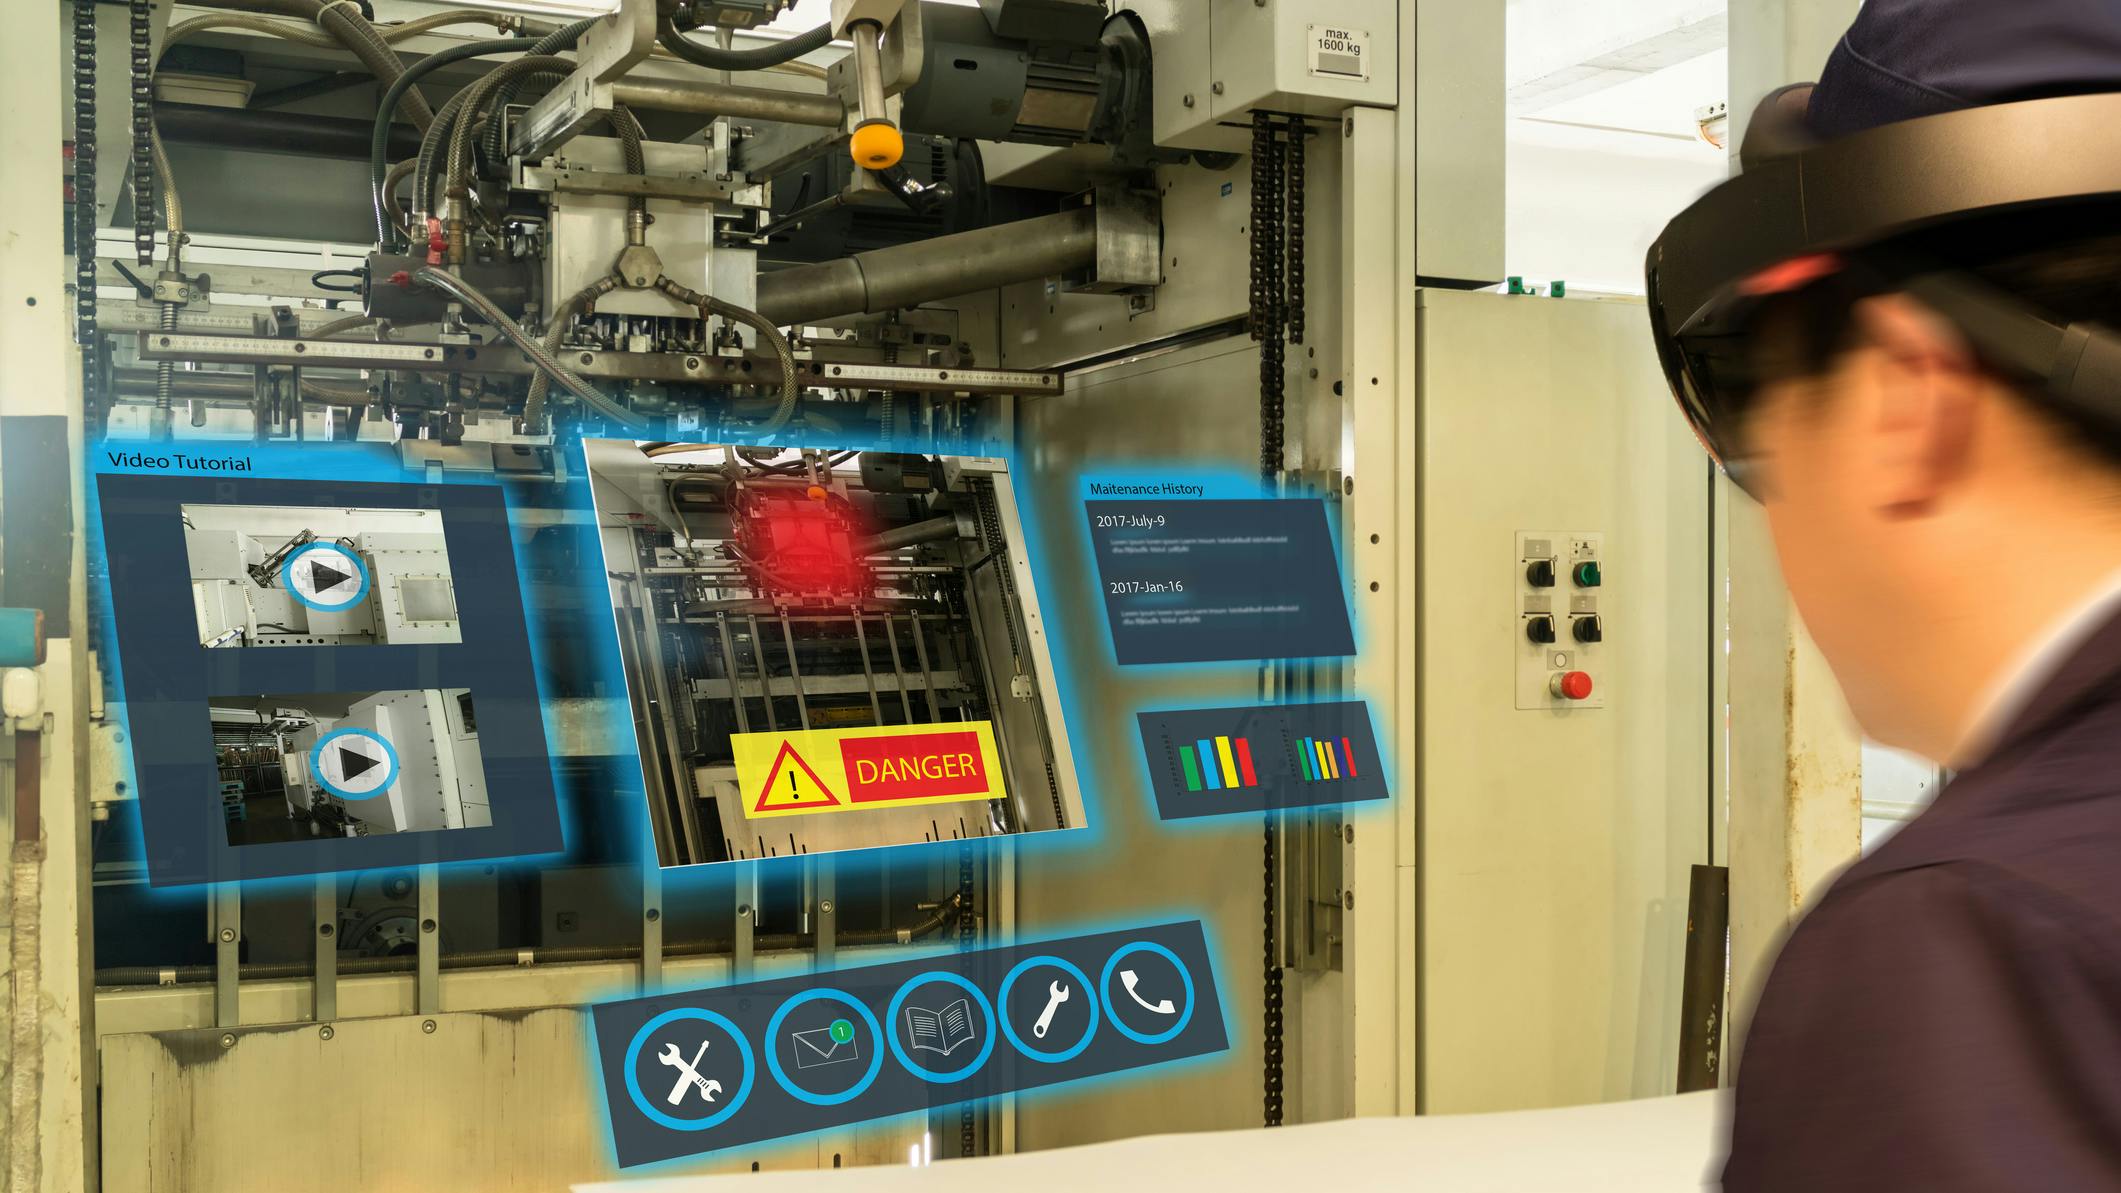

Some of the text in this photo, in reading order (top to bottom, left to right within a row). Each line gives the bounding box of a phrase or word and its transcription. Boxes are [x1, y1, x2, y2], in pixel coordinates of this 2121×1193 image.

[1325, 29, 1352, 41] max.
[1317, 38, 1361, 56] 1600 kg
